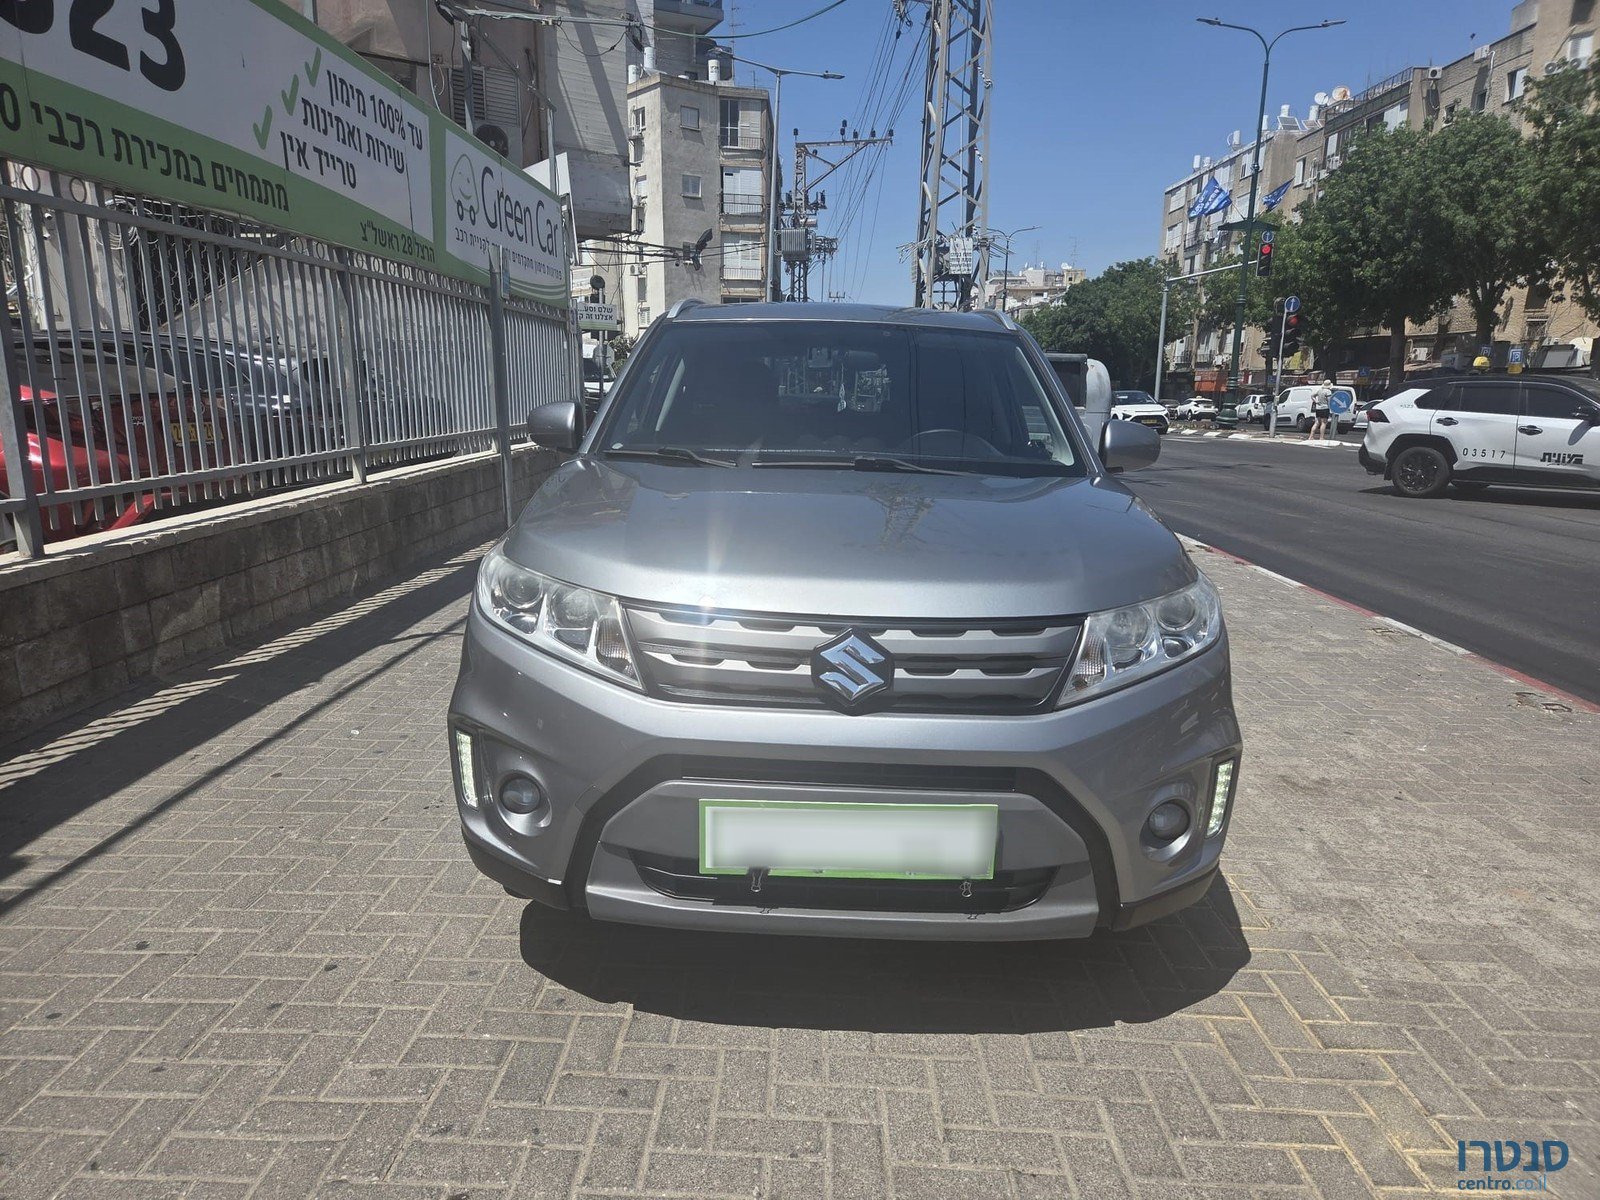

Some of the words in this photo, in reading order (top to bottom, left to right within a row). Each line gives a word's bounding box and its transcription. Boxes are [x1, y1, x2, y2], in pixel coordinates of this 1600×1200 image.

[0, 0, 186, 91] 23
[326, 69, 367, 117] מימון
[29, 100, 105, 157] רכבי
[301, 97, 363, 154] ואמינות
[370, 94, 406, 141] 100%
[407, 121, 424, 151] עד
[111, 127, 206, 187] במכירת
[280, 131, 310, 172] אין
[312, 145, 358, 190] טרייד
[366, 131, 406, 175] שירות
[211, 161, 289, 212] מתמחים
[481, 166, 534, 247] Green
[535, 199, 558, 258] Car
[401, 233, 413, 256] 28
[414, 238, 436, 264] הרצל
[455, 226, 468, 245] רכב
[1462, 446, 1506, 459] 03517
